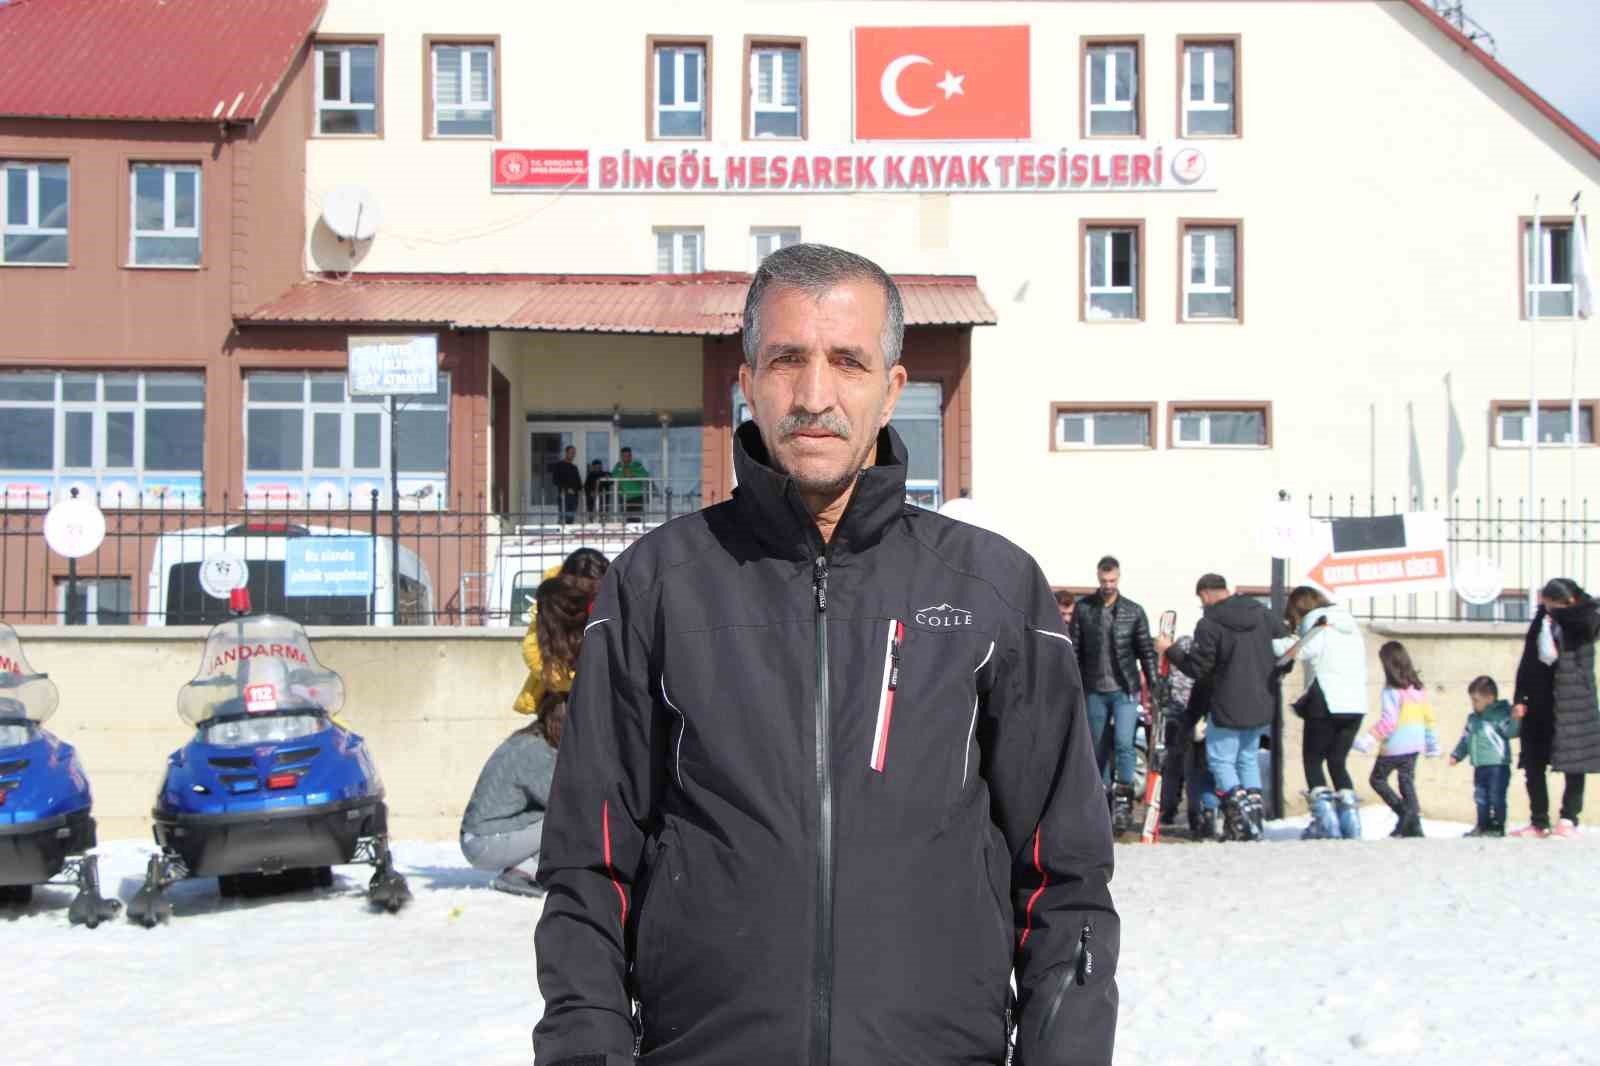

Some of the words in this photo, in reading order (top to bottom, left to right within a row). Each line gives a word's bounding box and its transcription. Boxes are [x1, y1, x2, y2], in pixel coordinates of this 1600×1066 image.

[600, 149, 719, 189] BİNGÖL
[726, 155, 876, 189] HESAREK
[884, 154, 990, 188] KAYAK
[996, 147, 1163, 188] TESİSLERİ
[915, 613, 973, 627] COLLE
[250, 687, 273, 700] 112
